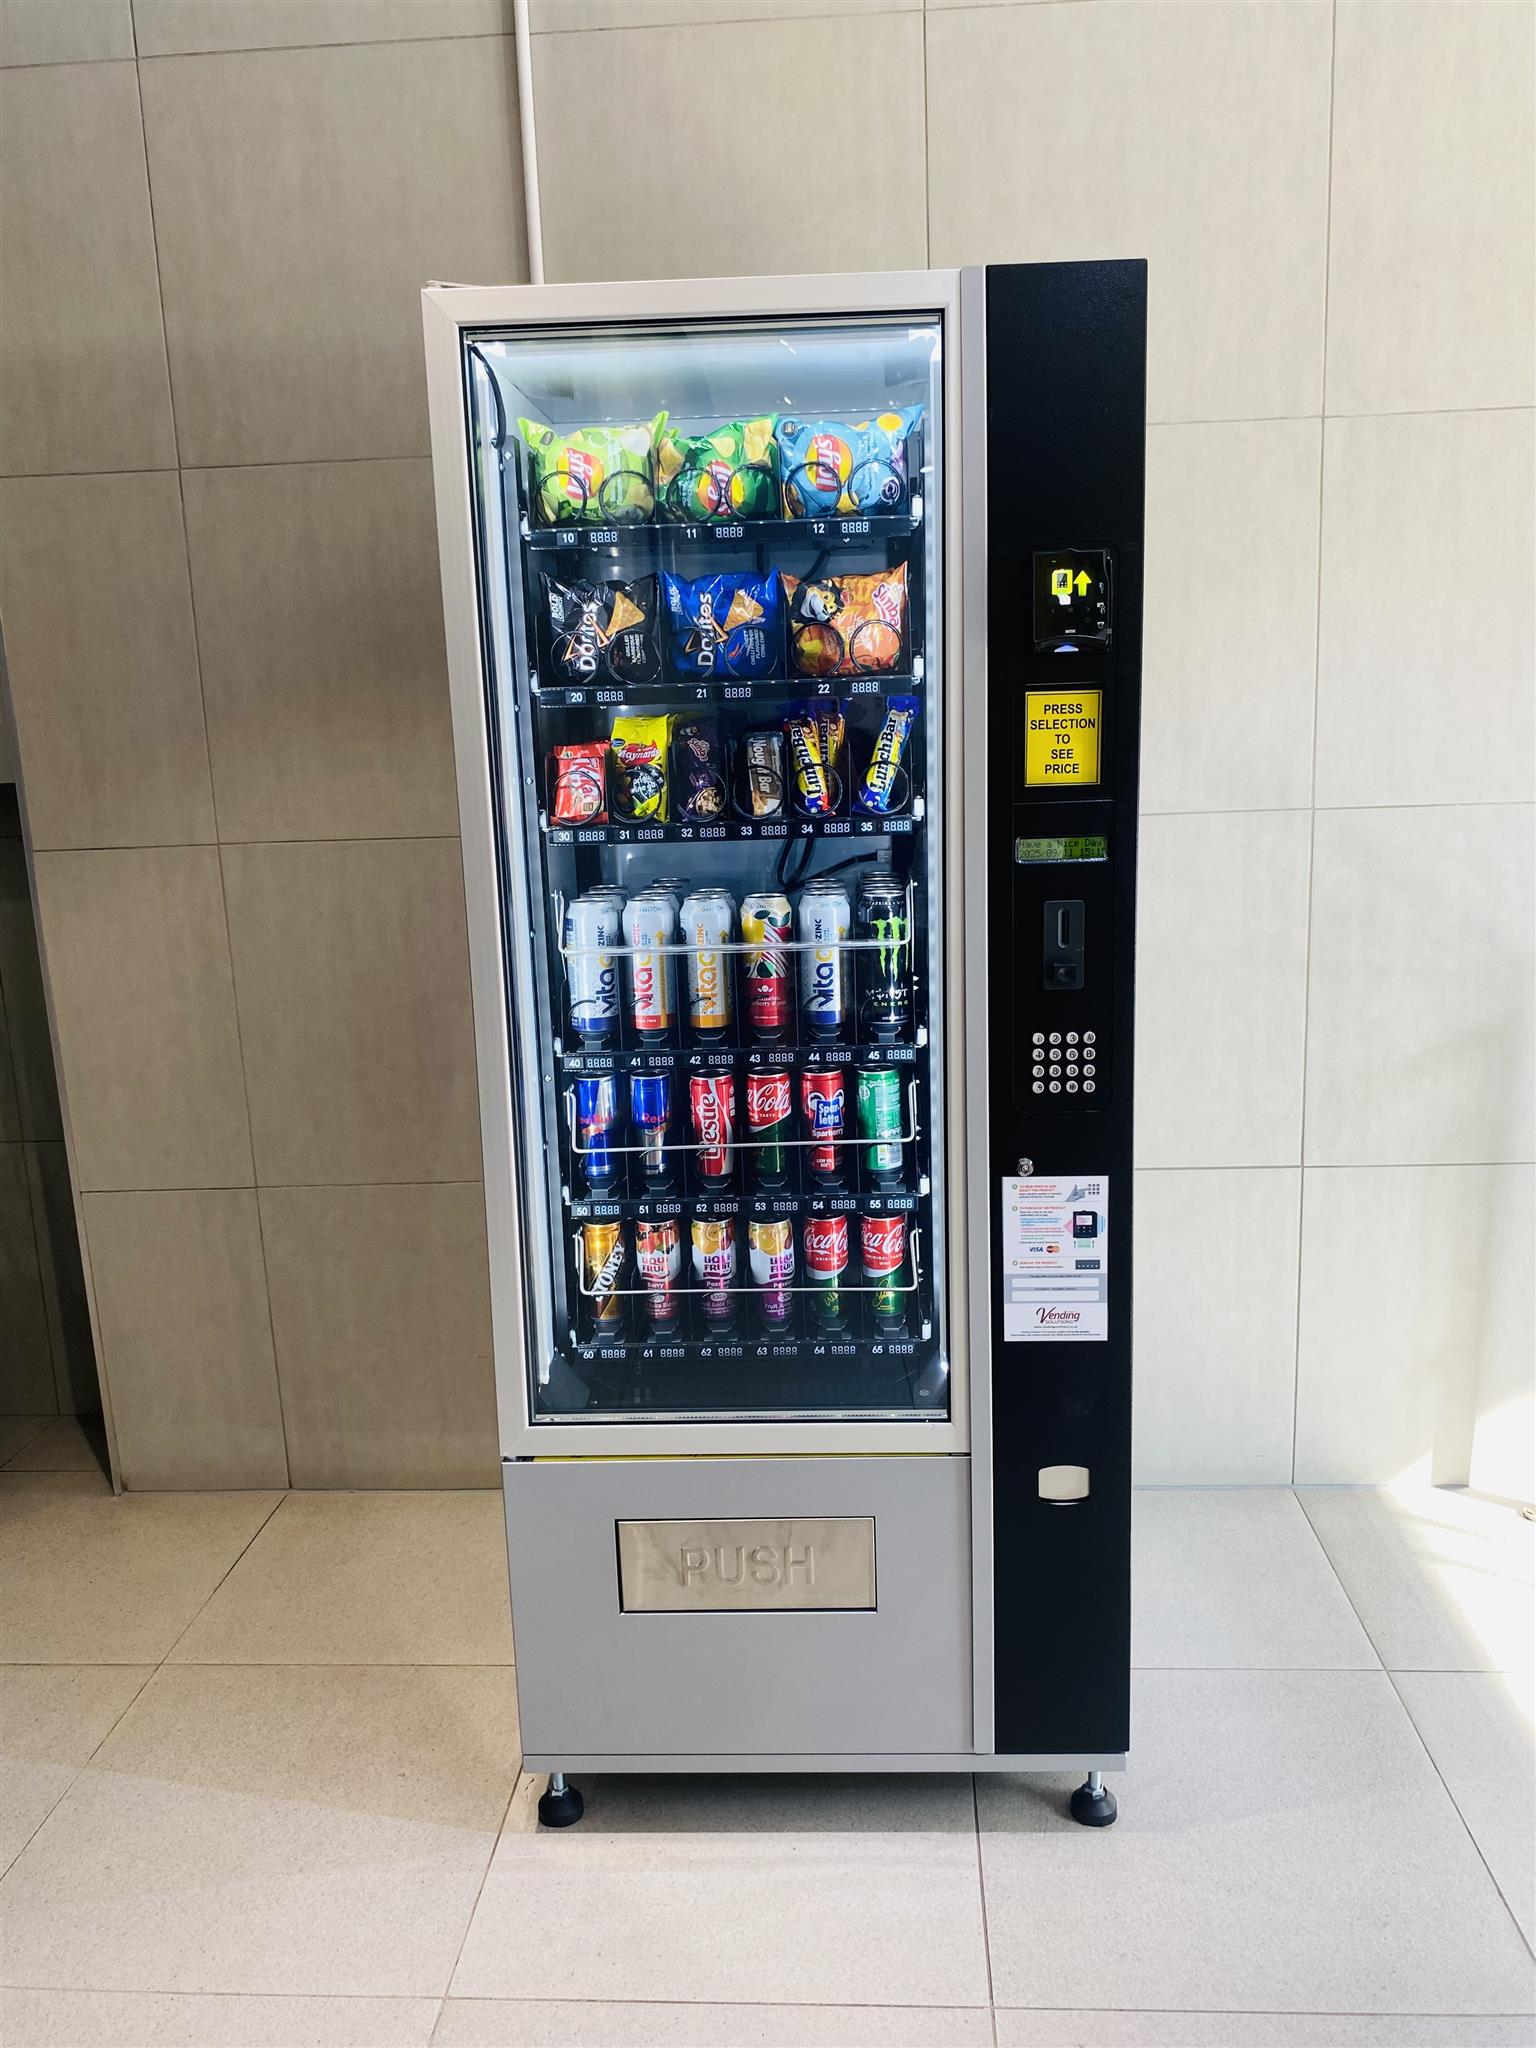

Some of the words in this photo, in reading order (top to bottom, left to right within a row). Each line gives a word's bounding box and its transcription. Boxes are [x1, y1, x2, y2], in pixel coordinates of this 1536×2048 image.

[813, 524, 824, 533] 12
[563, 534, 574, 542] 10
[687, 529, 696, 538] 11
[578, 600, 598, 671] Doritos
[818, 684, 830, 693] 22
[571, 693, 582, 701] 20
[696, 689, 706, 698] 21
[1044, 704, 1083, 714] PRESS
[1030, 718, 1096, 730] SELECTION
[1055, 734, 1071, 744] TO
[617, 746, 661, 763] Maynards
[1051, 749, 1073, 759] SEE
[1045, 764, 1080, 774] PRICE
[758, 776, 773, 793] Bar
[741, 827, 752, 835] 33
[802, 825, 813, 833] 34
[861, 822, 872, 831] 35
[559, 832, 569, 841] 30
[620, 831, 630, 839] 31
[681, 829, 692, 837] 32
[690, 1056, 700, 1064] 42
[809, 1053, 820, 1061] 44
[569, 1059, 580, 1068] 40
[631, 1058, 640, 1066] 41
[696, 1204, 707, 1212] 52
[813, 1201, 824, 1209] 54
[870, 1200, 880, 1208] 55
[1035, 1306, 1081, 1324] Vending
[701, 1348, 711, 1356] 62
[814, 1346, 825, 1354] 64
[583, 1351, 593, 1359] 60
[680, 1545, 816, 1587] PUSH
